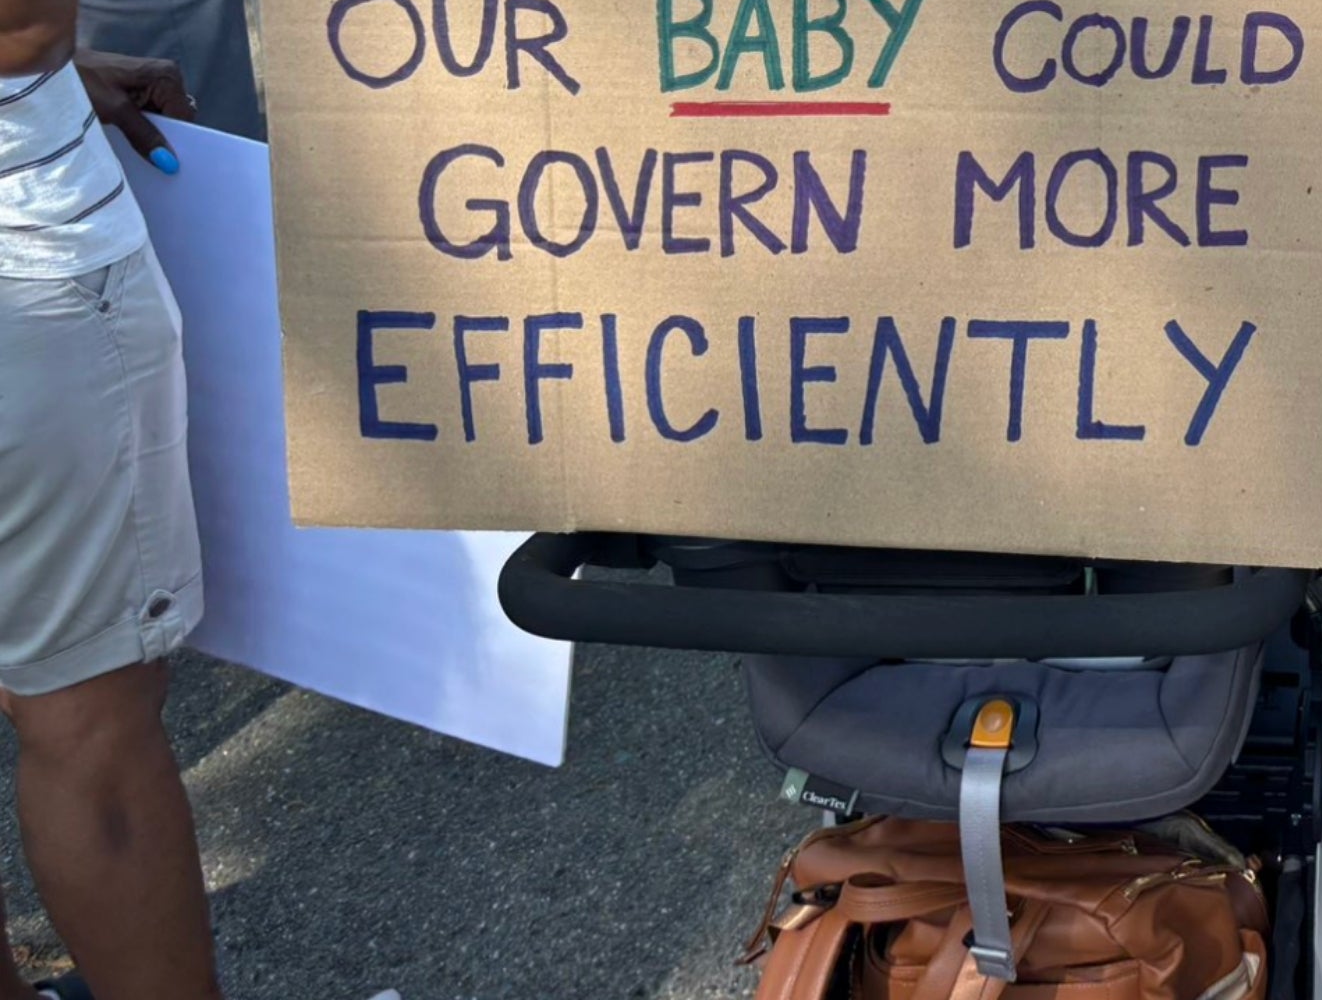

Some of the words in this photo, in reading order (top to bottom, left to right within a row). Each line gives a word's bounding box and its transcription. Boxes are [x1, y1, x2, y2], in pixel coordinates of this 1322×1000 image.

[993, 0, 1305, 94] COULD
[417, 143, 867, 260] GOVERN
[953, 147, 1250, 251] MORE
[354, 309, 1258, 449] EFFICIENTLY
[802, 790, 847, 809] ClearTex
